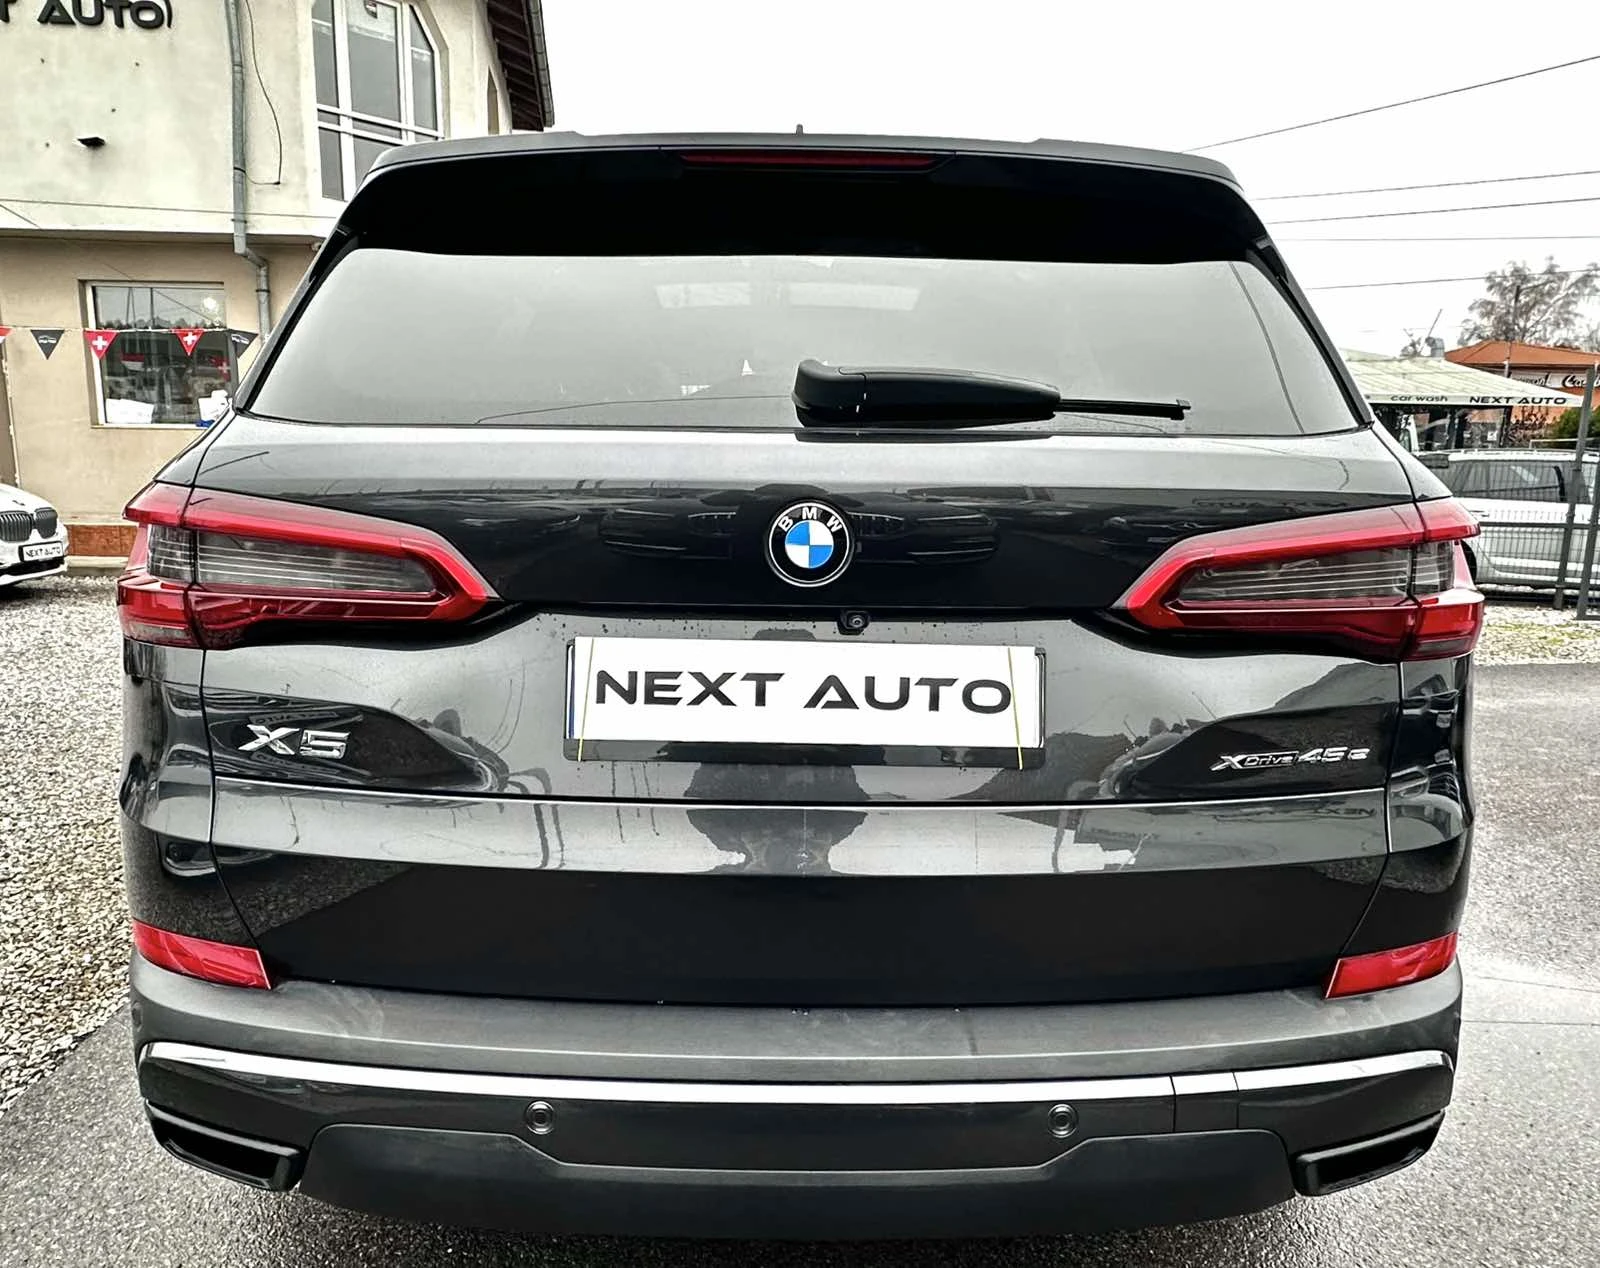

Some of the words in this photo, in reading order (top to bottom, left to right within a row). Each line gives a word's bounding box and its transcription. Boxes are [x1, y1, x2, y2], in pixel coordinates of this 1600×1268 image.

[37, 0, 165, 29] AUTO
[1469, 395, 1514, 404] NEXT
[1517, 396, 1567, 405] AUTO
[777, 506, 843, 532] BMW
[596, 670, 785, 708] NEXT
[803, 674, 1011, 714] AUTO
[237, 724, 351, 759] X5
